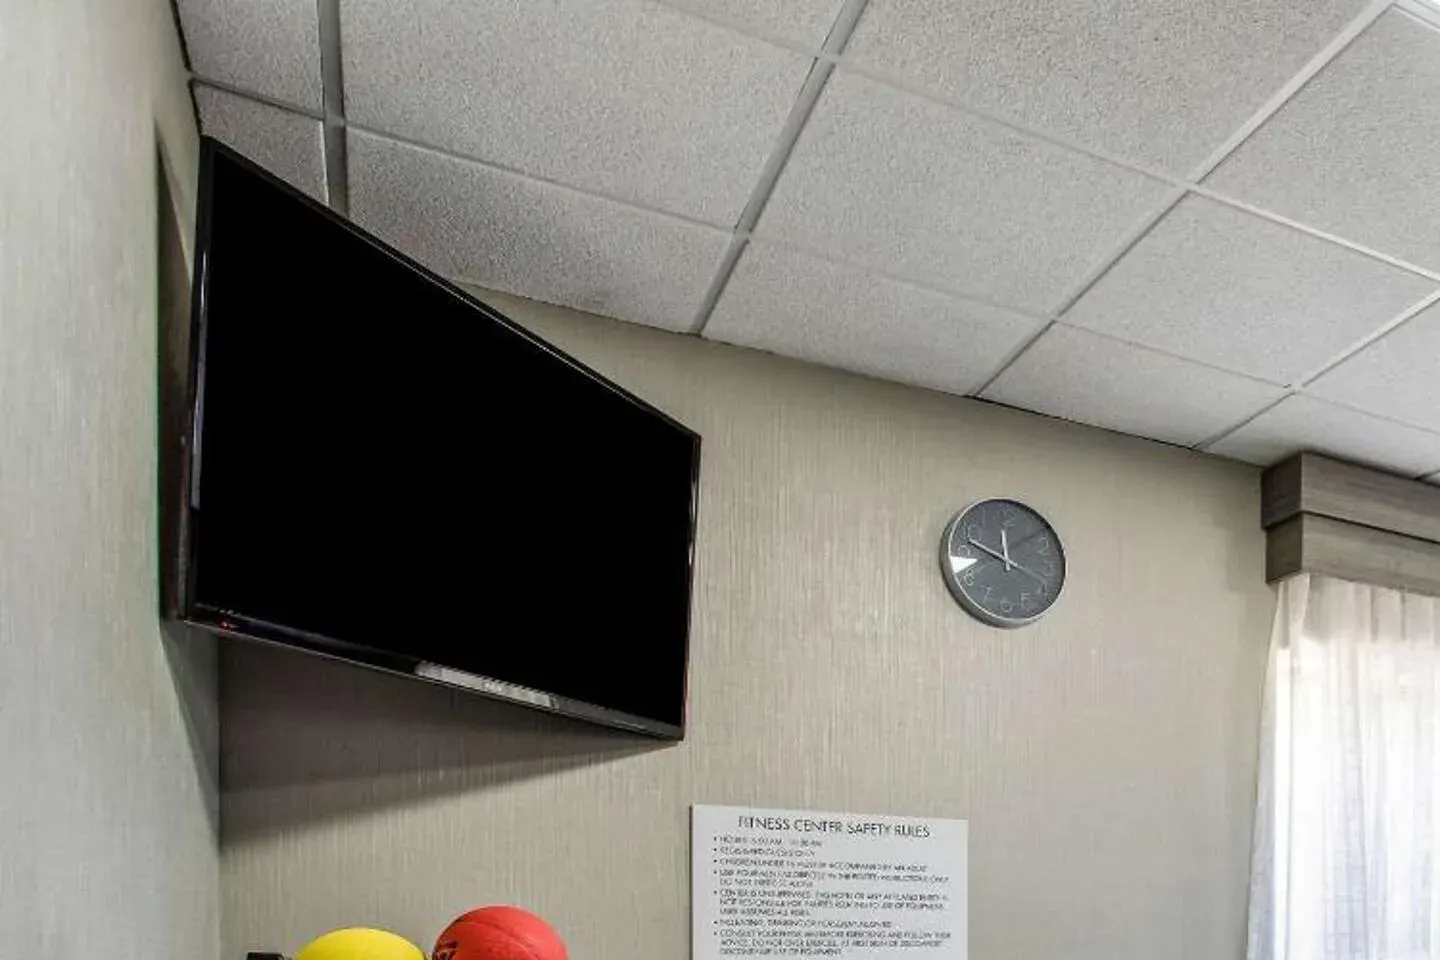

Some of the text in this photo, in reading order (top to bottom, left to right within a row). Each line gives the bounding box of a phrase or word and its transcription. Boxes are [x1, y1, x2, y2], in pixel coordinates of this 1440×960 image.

[738, 815, 930, 838] FITNESS CENTER SAFETY RULES
